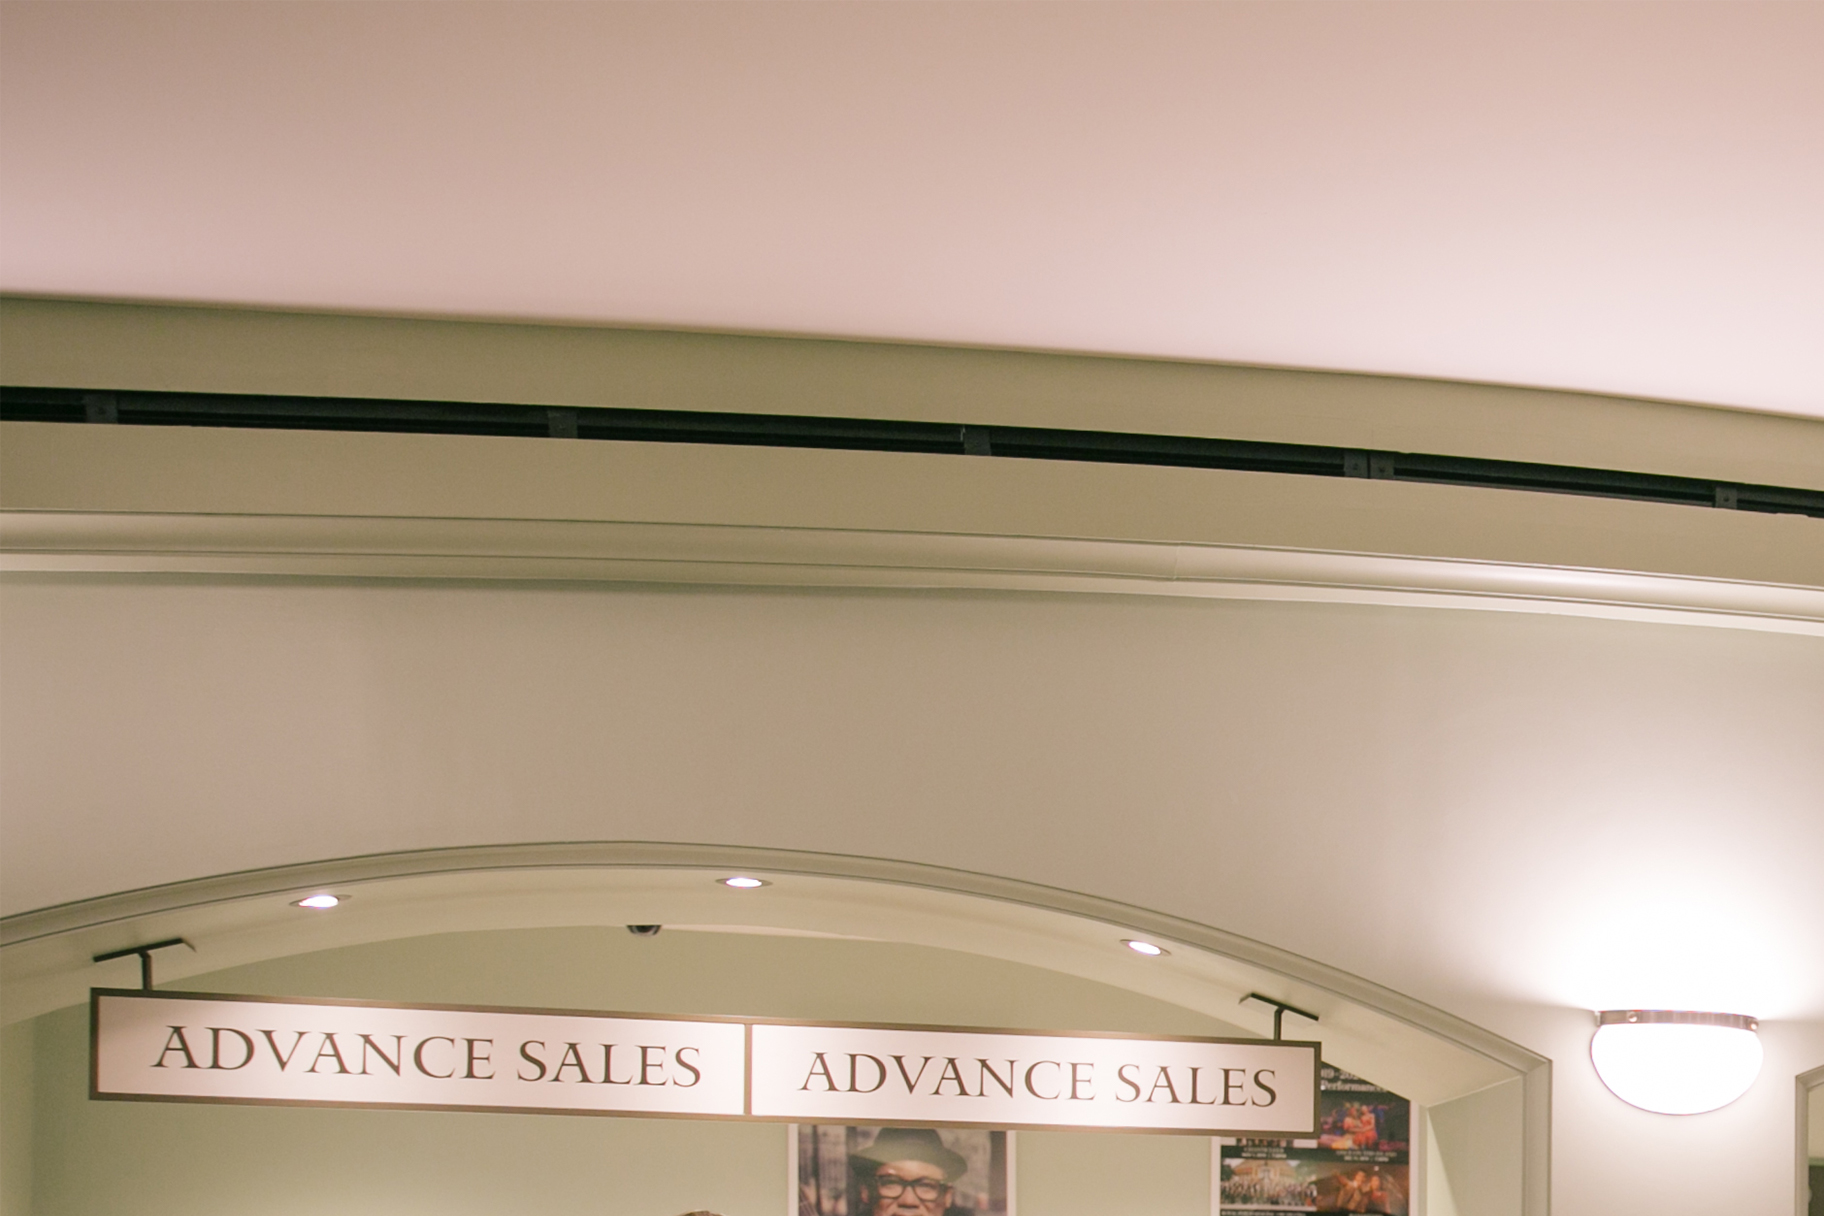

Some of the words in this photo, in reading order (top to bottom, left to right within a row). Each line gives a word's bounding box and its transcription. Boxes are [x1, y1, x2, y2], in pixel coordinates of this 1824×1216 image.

[150, 1024, 495, 1080] ADVANCE
[516, 1039, 702, 1089] SALES
[798, 1051, 1096, 1102] ADVANCE
[1115, 1063, 1278, 1109] SALES
